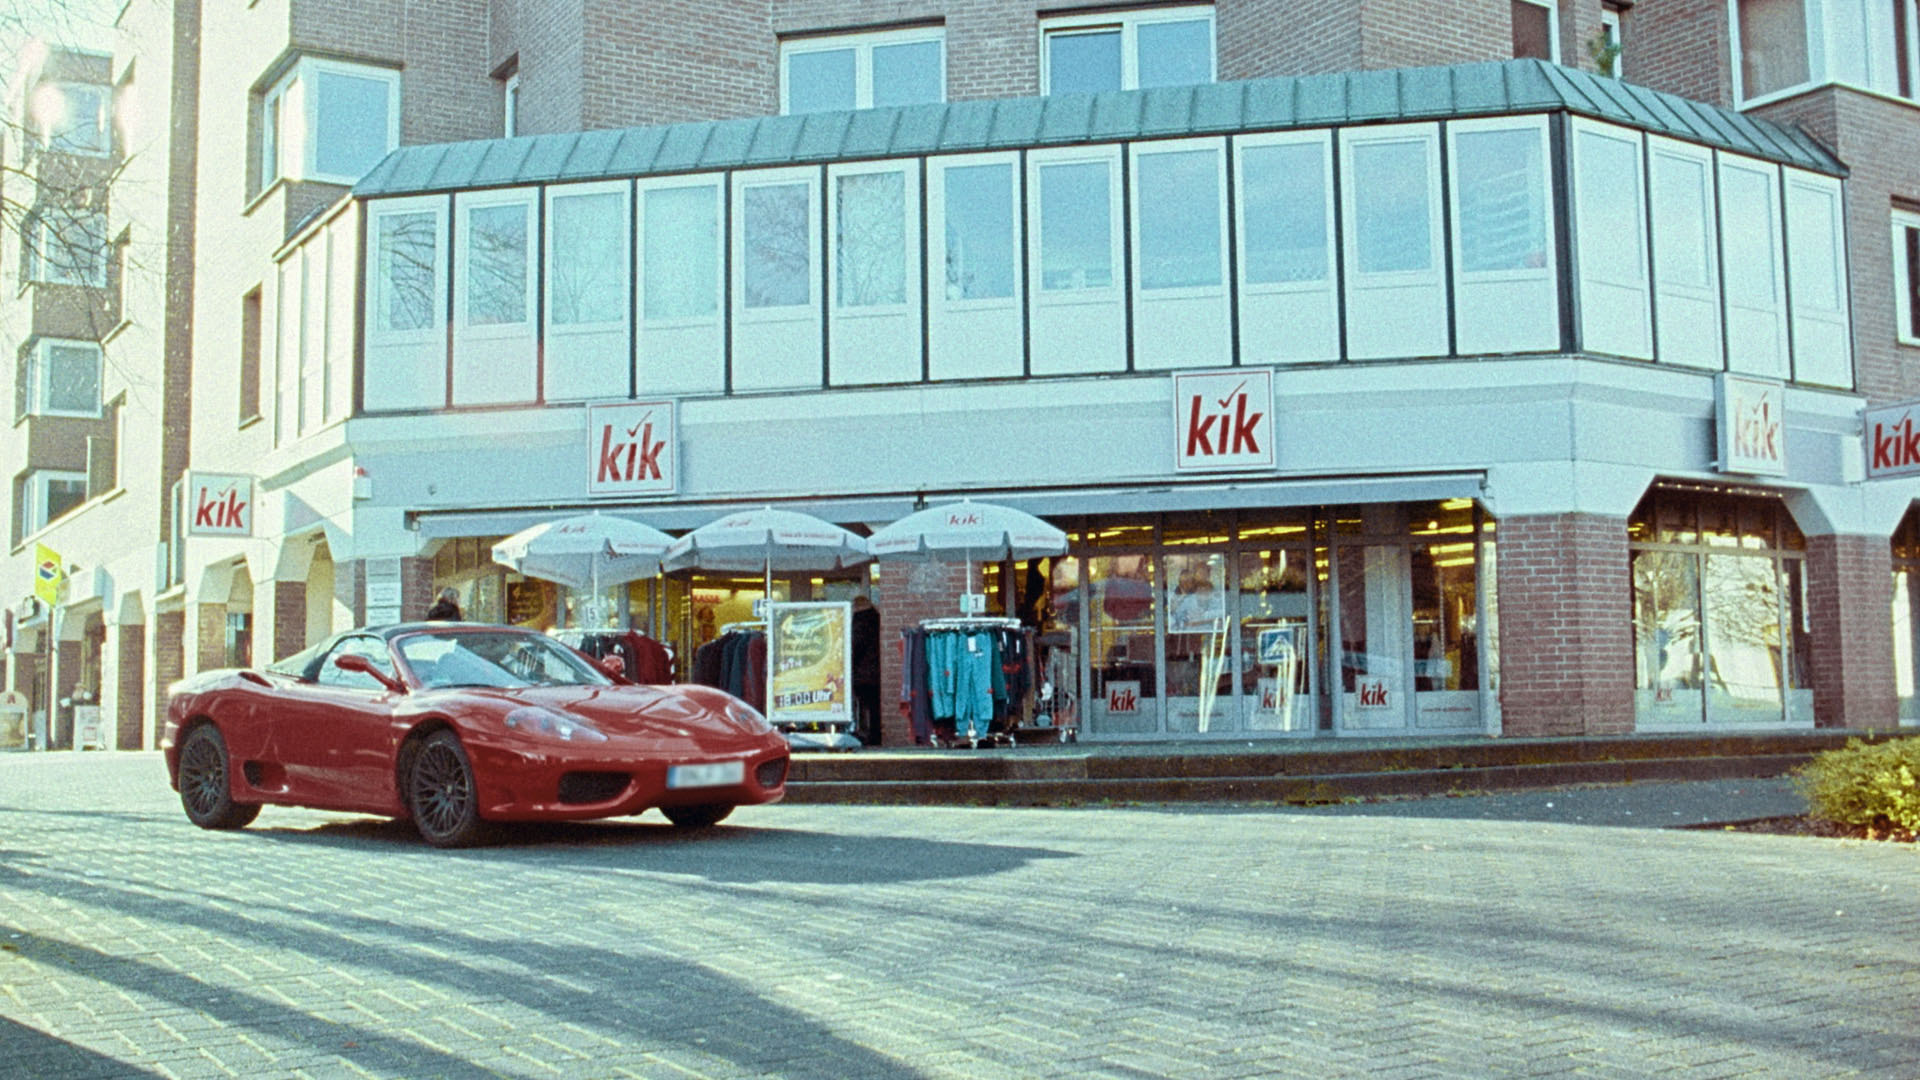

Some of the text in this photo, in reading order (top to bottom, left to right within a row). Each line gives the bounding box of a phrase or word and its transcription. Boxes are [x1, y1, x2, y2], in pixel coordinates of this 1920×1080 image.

[598, 411, 666, 482] kik
[1186, 380, 1264, 456] kik
[1734, 391, 1779, 461] kik
[1873, 409, 1920, 469] kik
[196, 483, 249, 528] kik
[1110, 689, 1137, 712] kik
[1360, 682, 1388, 706] kik
